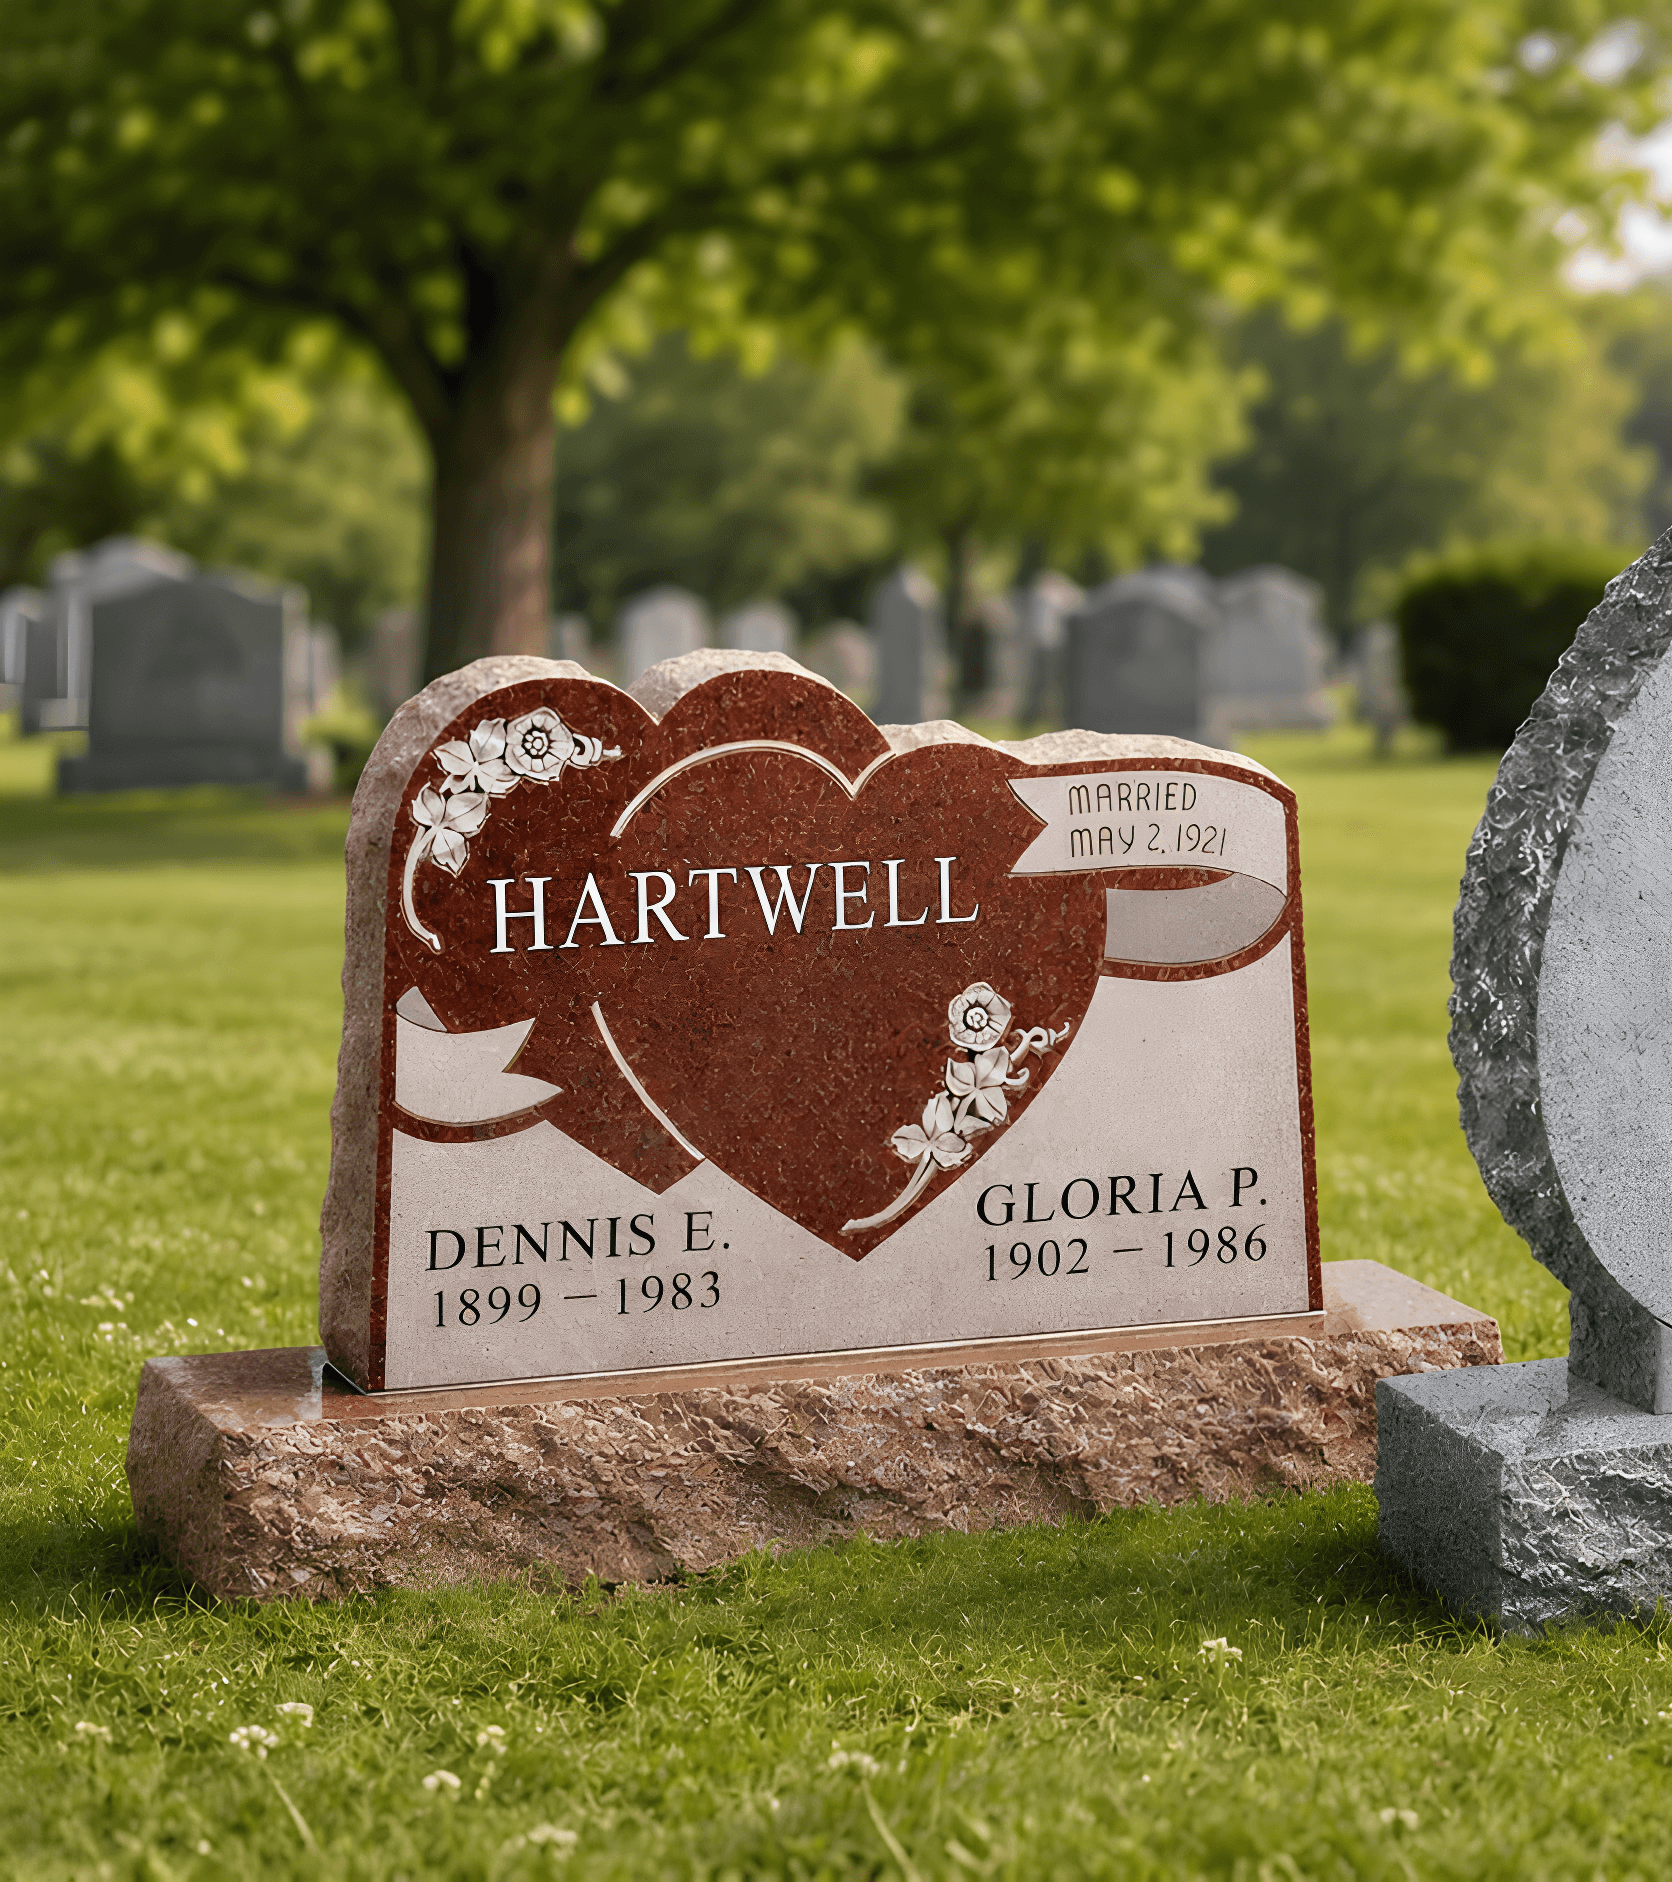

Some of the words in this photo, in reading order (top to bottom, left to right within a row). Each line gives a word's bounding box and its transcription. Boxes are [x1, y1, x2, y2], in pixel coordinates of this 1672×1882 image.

[1068, 782, 1197, 816] MARRIED
[1070, 825, 1135, 858] MAY
[1176, 823, 1226, 857] 1921
[487, 856, 980, 954] HARTWELL
[976, 1169, 1209, 1226] GLORIA
[1229, 1166, 1267, 1208] P.
[424, 1213, 656, 1271] DENNIS
[682, 1210, 730, 1252] E.
[984, 1238, 1090, 1281] 1902
[1163, 1223, 1267, 1268] 1986
[433, 1283, 542, 1327] 1899
[617, 1270, 721, 1314] 1983
